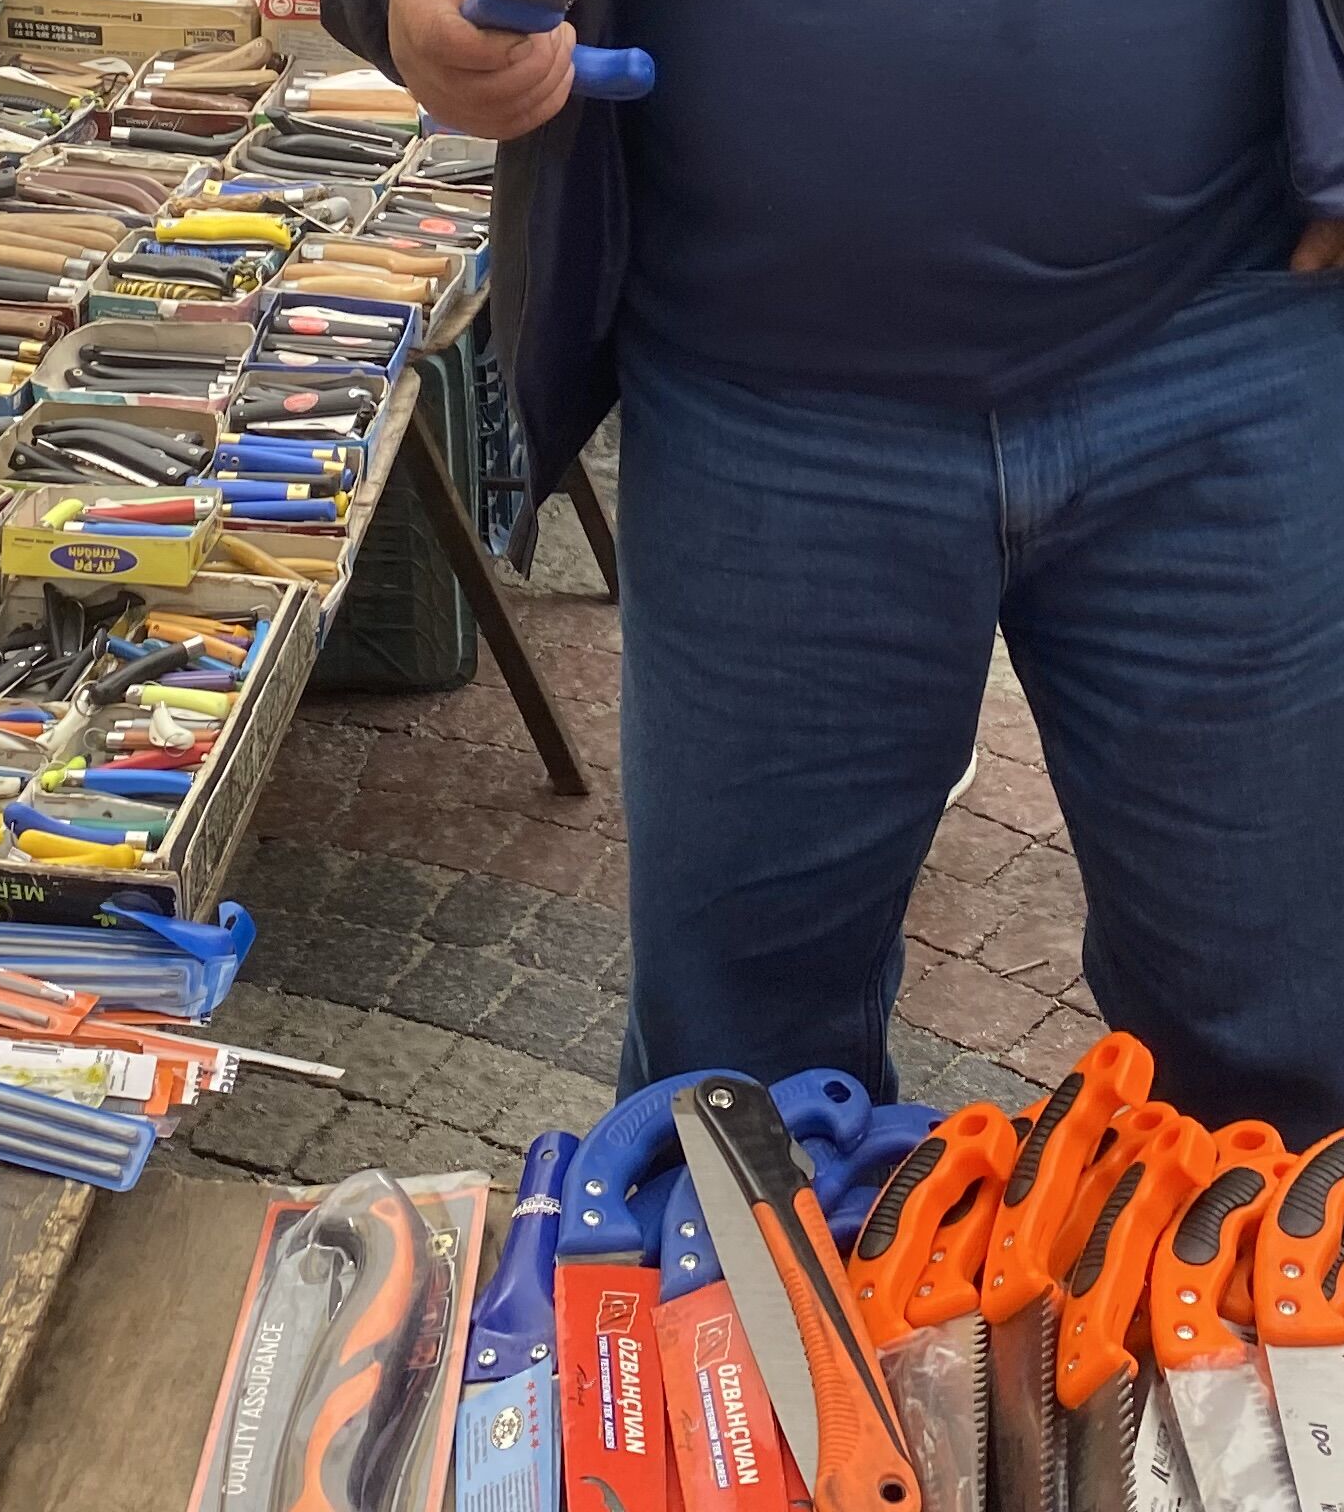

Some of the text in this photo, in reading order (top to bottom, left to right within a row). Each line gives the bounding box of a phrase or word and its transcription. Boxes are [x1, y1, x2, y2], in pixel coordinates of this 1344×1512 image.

[68, 546, 120, 561] YATAĞAN
[74, 559, 115, 573] AY-PA
[236, 1321, 286, 1418] ASSURANCE
[617, 1338, 646, 1454] ÖZBAHÇIVAN
[222, 1408, 259, 1496] QUALITY
[717, 1363, 760, 1486] ÖZBAHÇIVAN
[1308, 1422, 1333, 1456] 100
